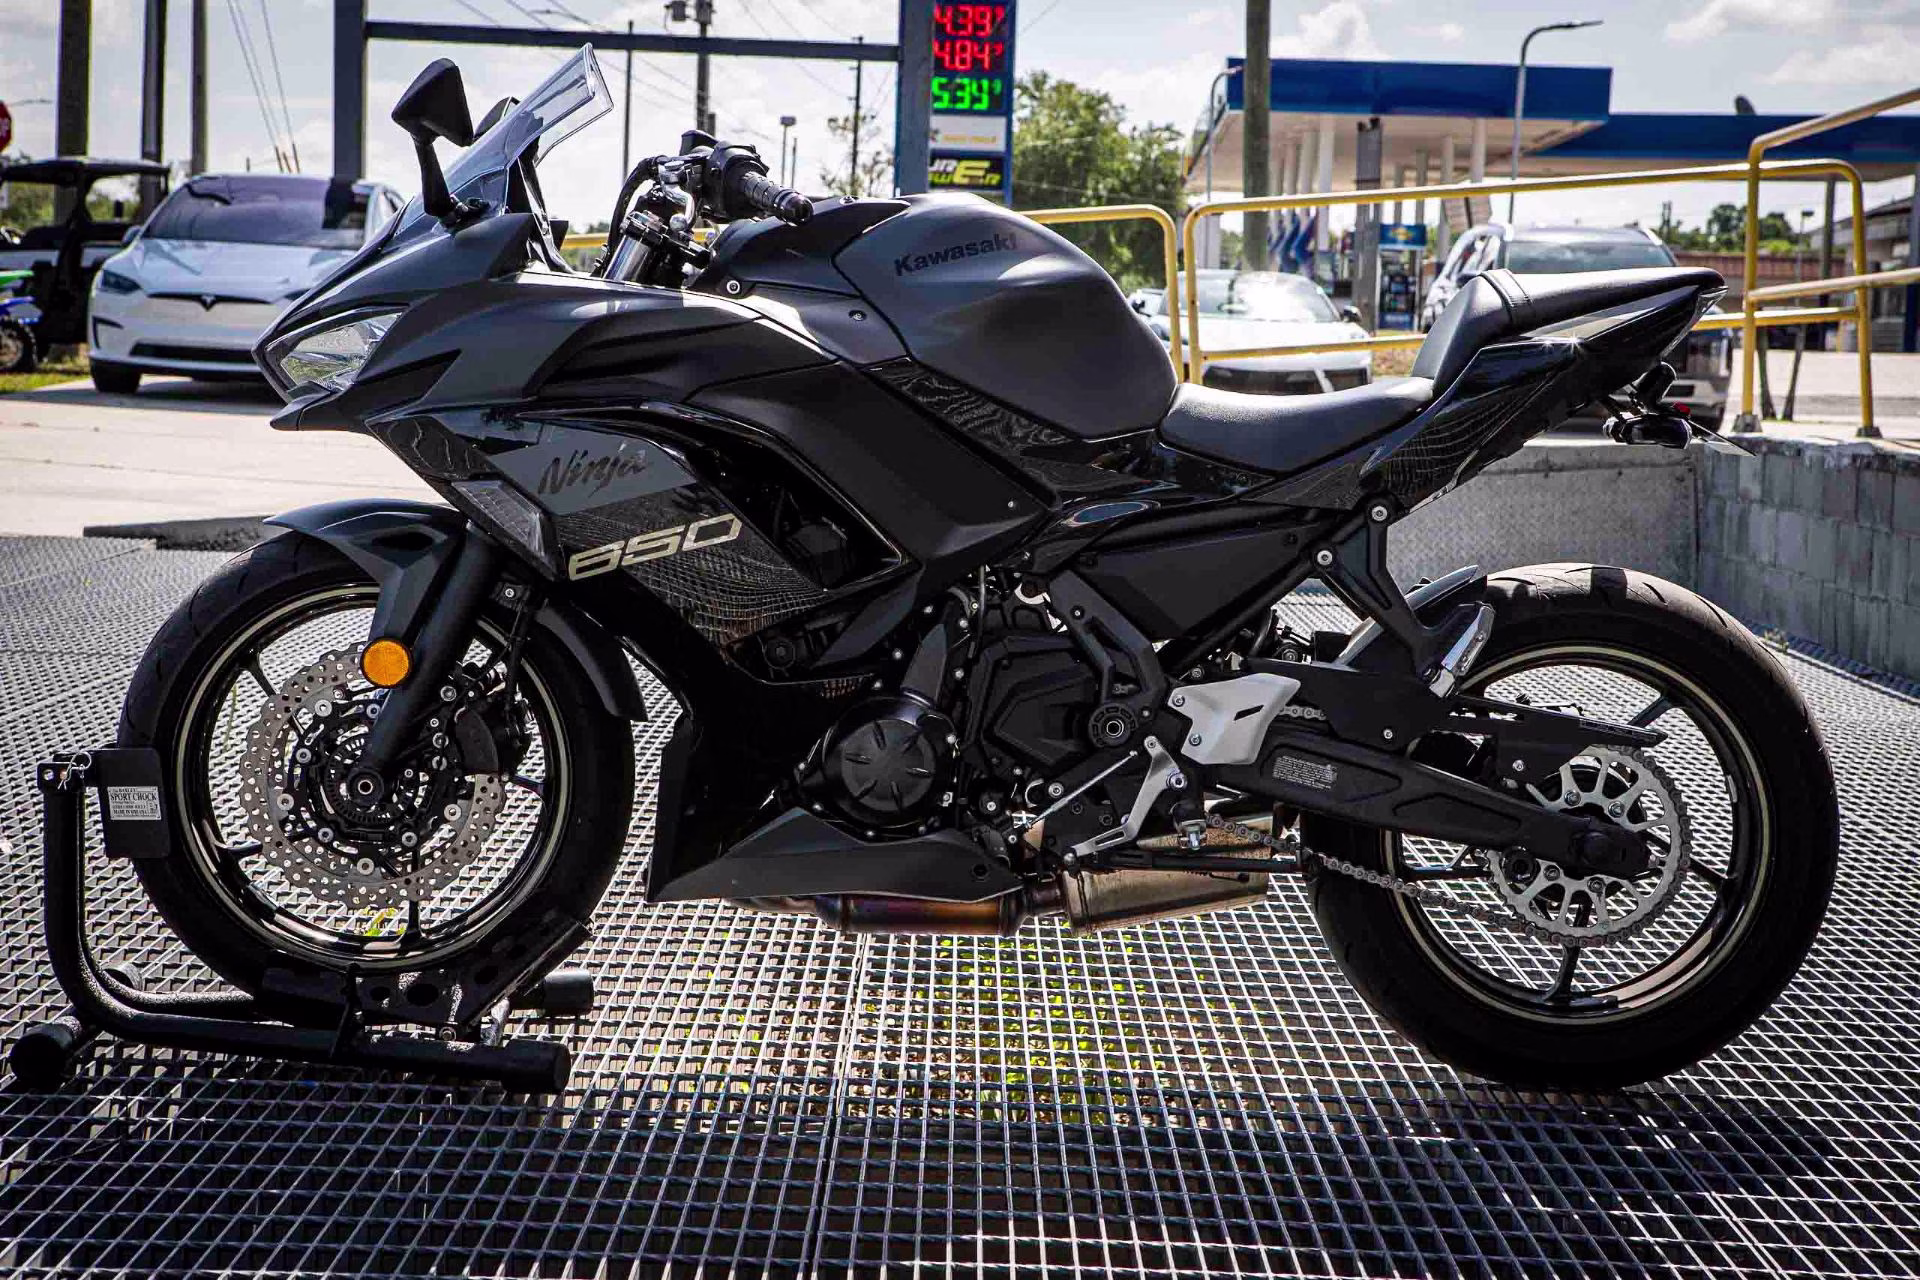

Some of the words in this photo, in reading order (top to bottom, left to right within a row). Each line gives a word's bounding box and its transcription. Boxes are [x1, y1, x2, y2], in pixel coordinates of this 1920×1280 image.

[894, 233, 1016, 276] Kawasaki
[538, 449, 648, 498] Ninja
[568, 513, 743, 581] 650
[111, 792, 131, 801] SPORT
[132, 792, 157, 801] CHOCK
